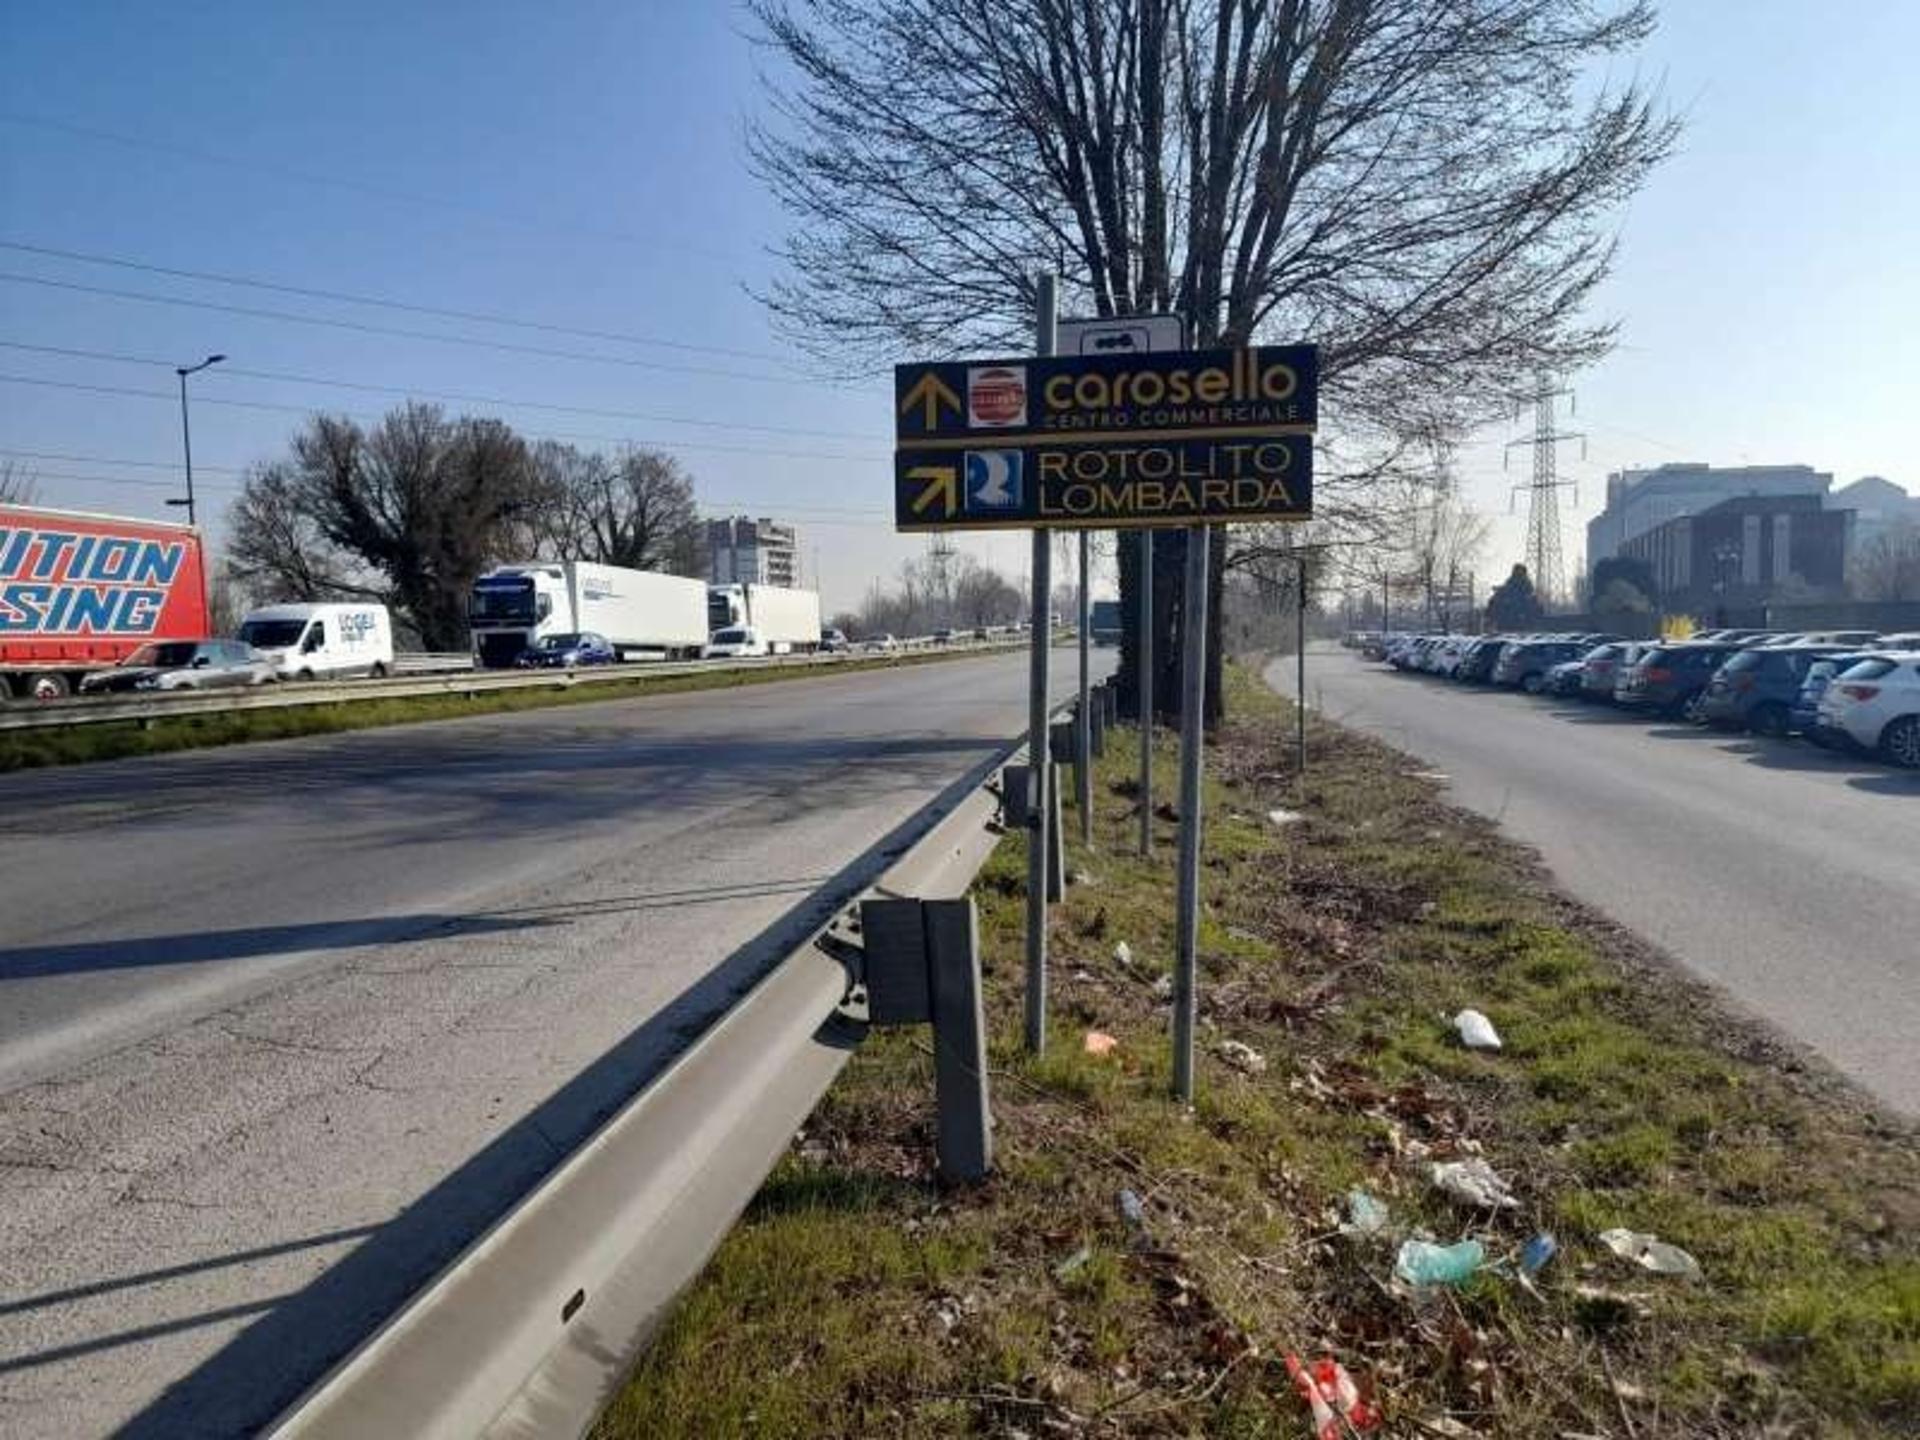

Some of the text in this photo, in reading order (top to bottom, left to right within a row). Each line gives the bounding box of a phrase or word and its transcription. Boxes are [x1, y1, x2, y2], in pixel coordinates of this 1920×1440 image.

[1044, 346, 1298, 410] carosello
[1043, 404, 1299, 429] CENTRO COMMERCIALE
[1038, 443, 1292, 481] ROTOLITO
[1039, 478, 1293, 515] LOMBARDA
